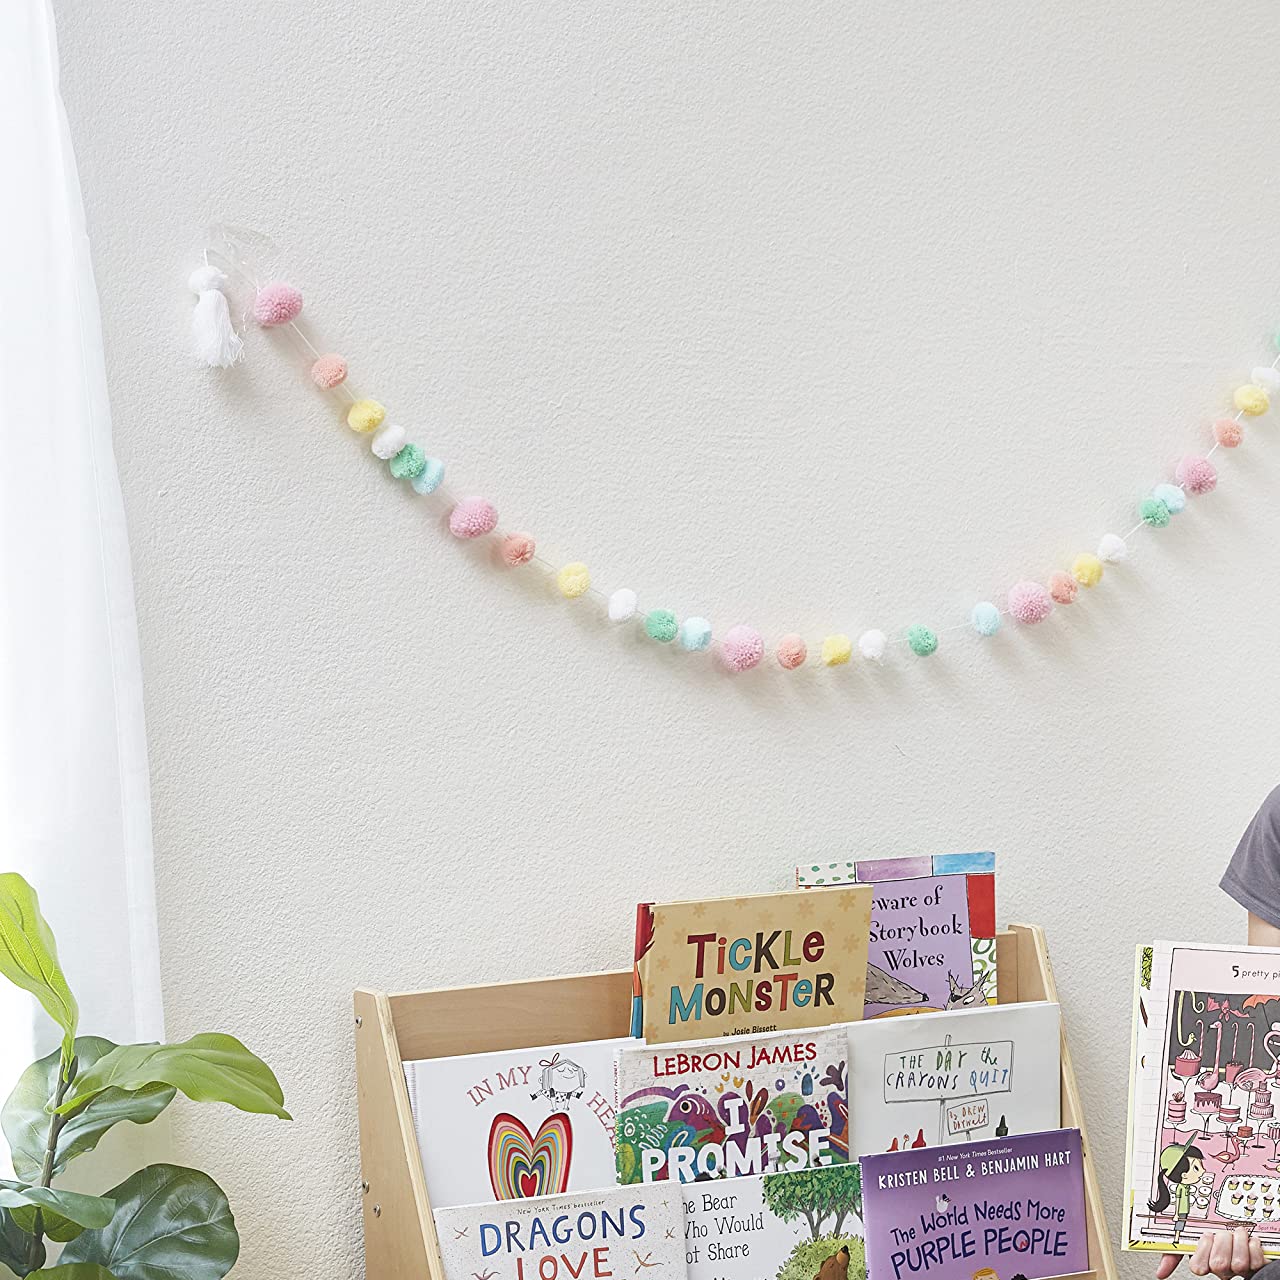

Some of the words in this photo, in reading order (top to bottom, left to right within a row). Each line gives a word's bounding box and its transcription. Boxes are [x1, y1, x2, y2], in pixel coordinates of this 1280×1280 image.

[924, 885, 944, 907] of
[869, 914, 964, 943] Storybook
[882, 949, 945, 971] Wolves
[1232, 965, 1240, 978] 5
[1241, 970, 1270, 980] pretty
[731, 1027, 750, 1036] Josie
[752, 1024, 777, 1034] Bissett
[653, 1050, 741, 1078] LEBRON
[747, 1042, 817, 1070] JAMES
[900, 1054, 924, 1069] THE
[936, 1050, 968, 1072] DAY
[980, 1046, 998, 1066] the
[886, 1071, 959, 1090] CRAYONS
[969, 1068, 1009, 1093] QUIT
[466, 1078, 494, 1107] IN
[495, 1065, 533, 1091] MY
[585, 1091, 617, 1157] HEA
[723, 1098, 746, 1136] I
[962, 1104, 985, 1118] DREW
[640, 1128, 833, 1184] PROMISE
[878, 1170, 928, 1190] KRISTEN
[933, 1166, 960, 1182] BELL
[966, 1163, 976, 1178] &
[981, 1156, 1039, 1175] BENJAMIN
[1045, 1150, 1072, 1168] HART
[702, 1194, 738, 1212] Bear
[479, 1204, 646, 1257] DRAGONS
[714, 1212, 764, 1235] Would
[890, 1227, 916, 1247] The
[920, 1205, 969, 1235] World
[1027, 1199, 1066, 1223] More
[707, 1243, 750, 1261] Share
[890, 1230, 976, 1280] PURPLE
[983, 1226, 1069, 1257] PEOPLE
